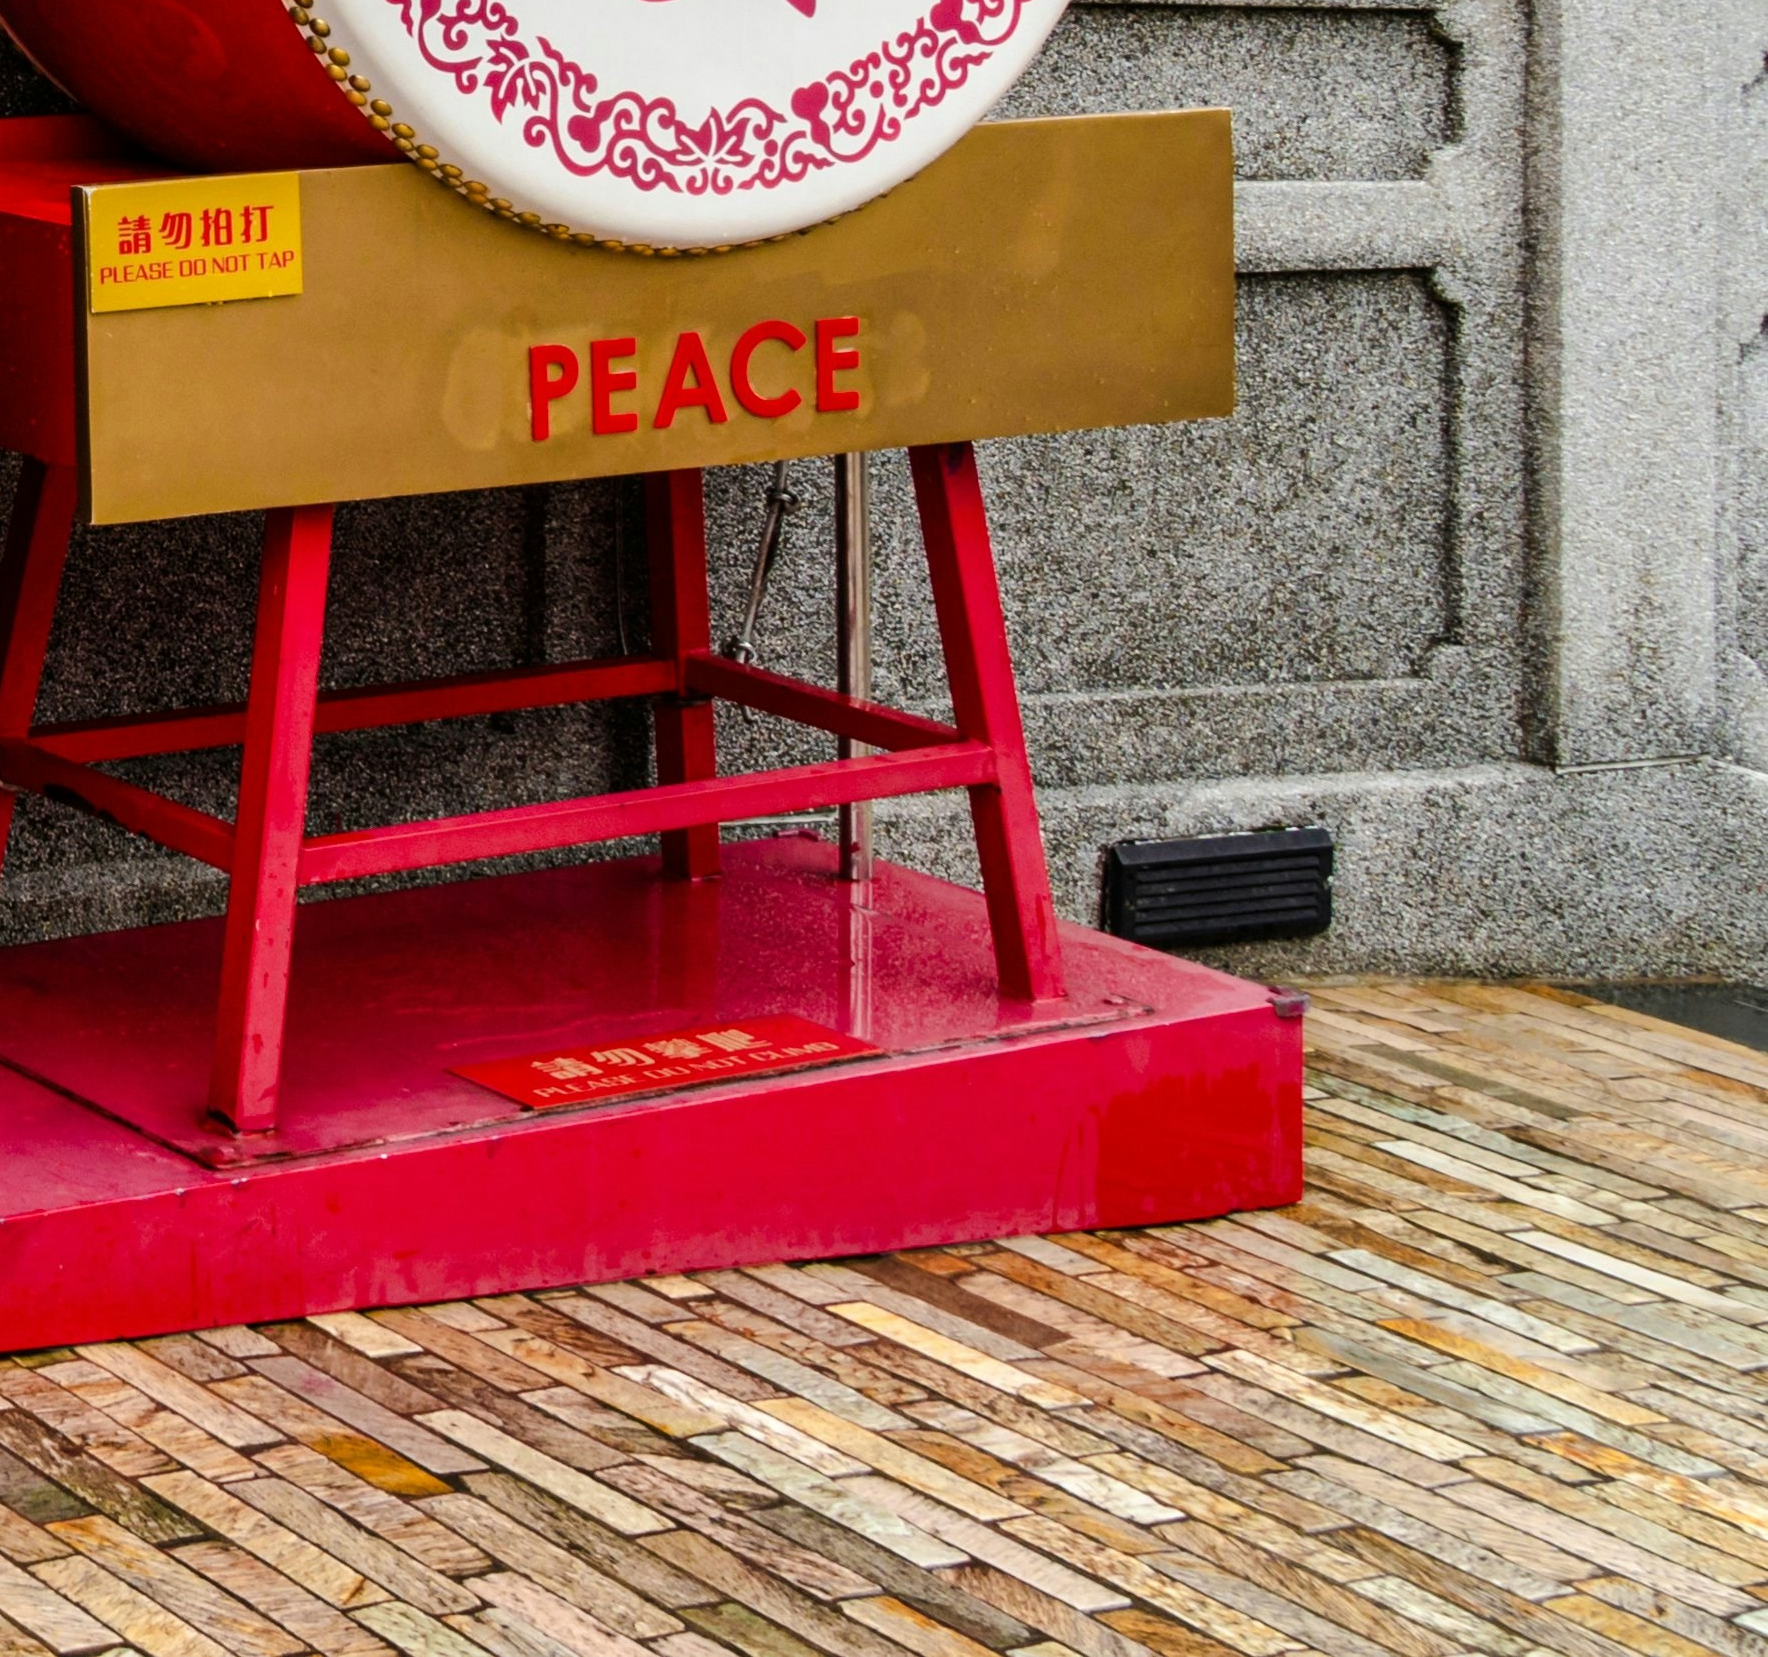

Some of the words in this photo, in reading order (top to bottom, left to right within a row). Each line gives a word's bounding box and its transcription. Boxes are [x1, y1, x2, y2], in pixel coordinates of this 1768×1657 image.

[117, 206, 274, 255] 請勿拍打
[100, 261, 174, 285] PLEASE
[179, 258, 206, 278] DO
[212, 254, 251, 274] NOT
[257, 250, 295, 270] TAP
[529, 315, 860, 442] PEACE
[532, 1074, 646, 1098] PLEASE
[643, 1066, 691, 1080] DO
[688, 1055, 748, 1071] NOT
